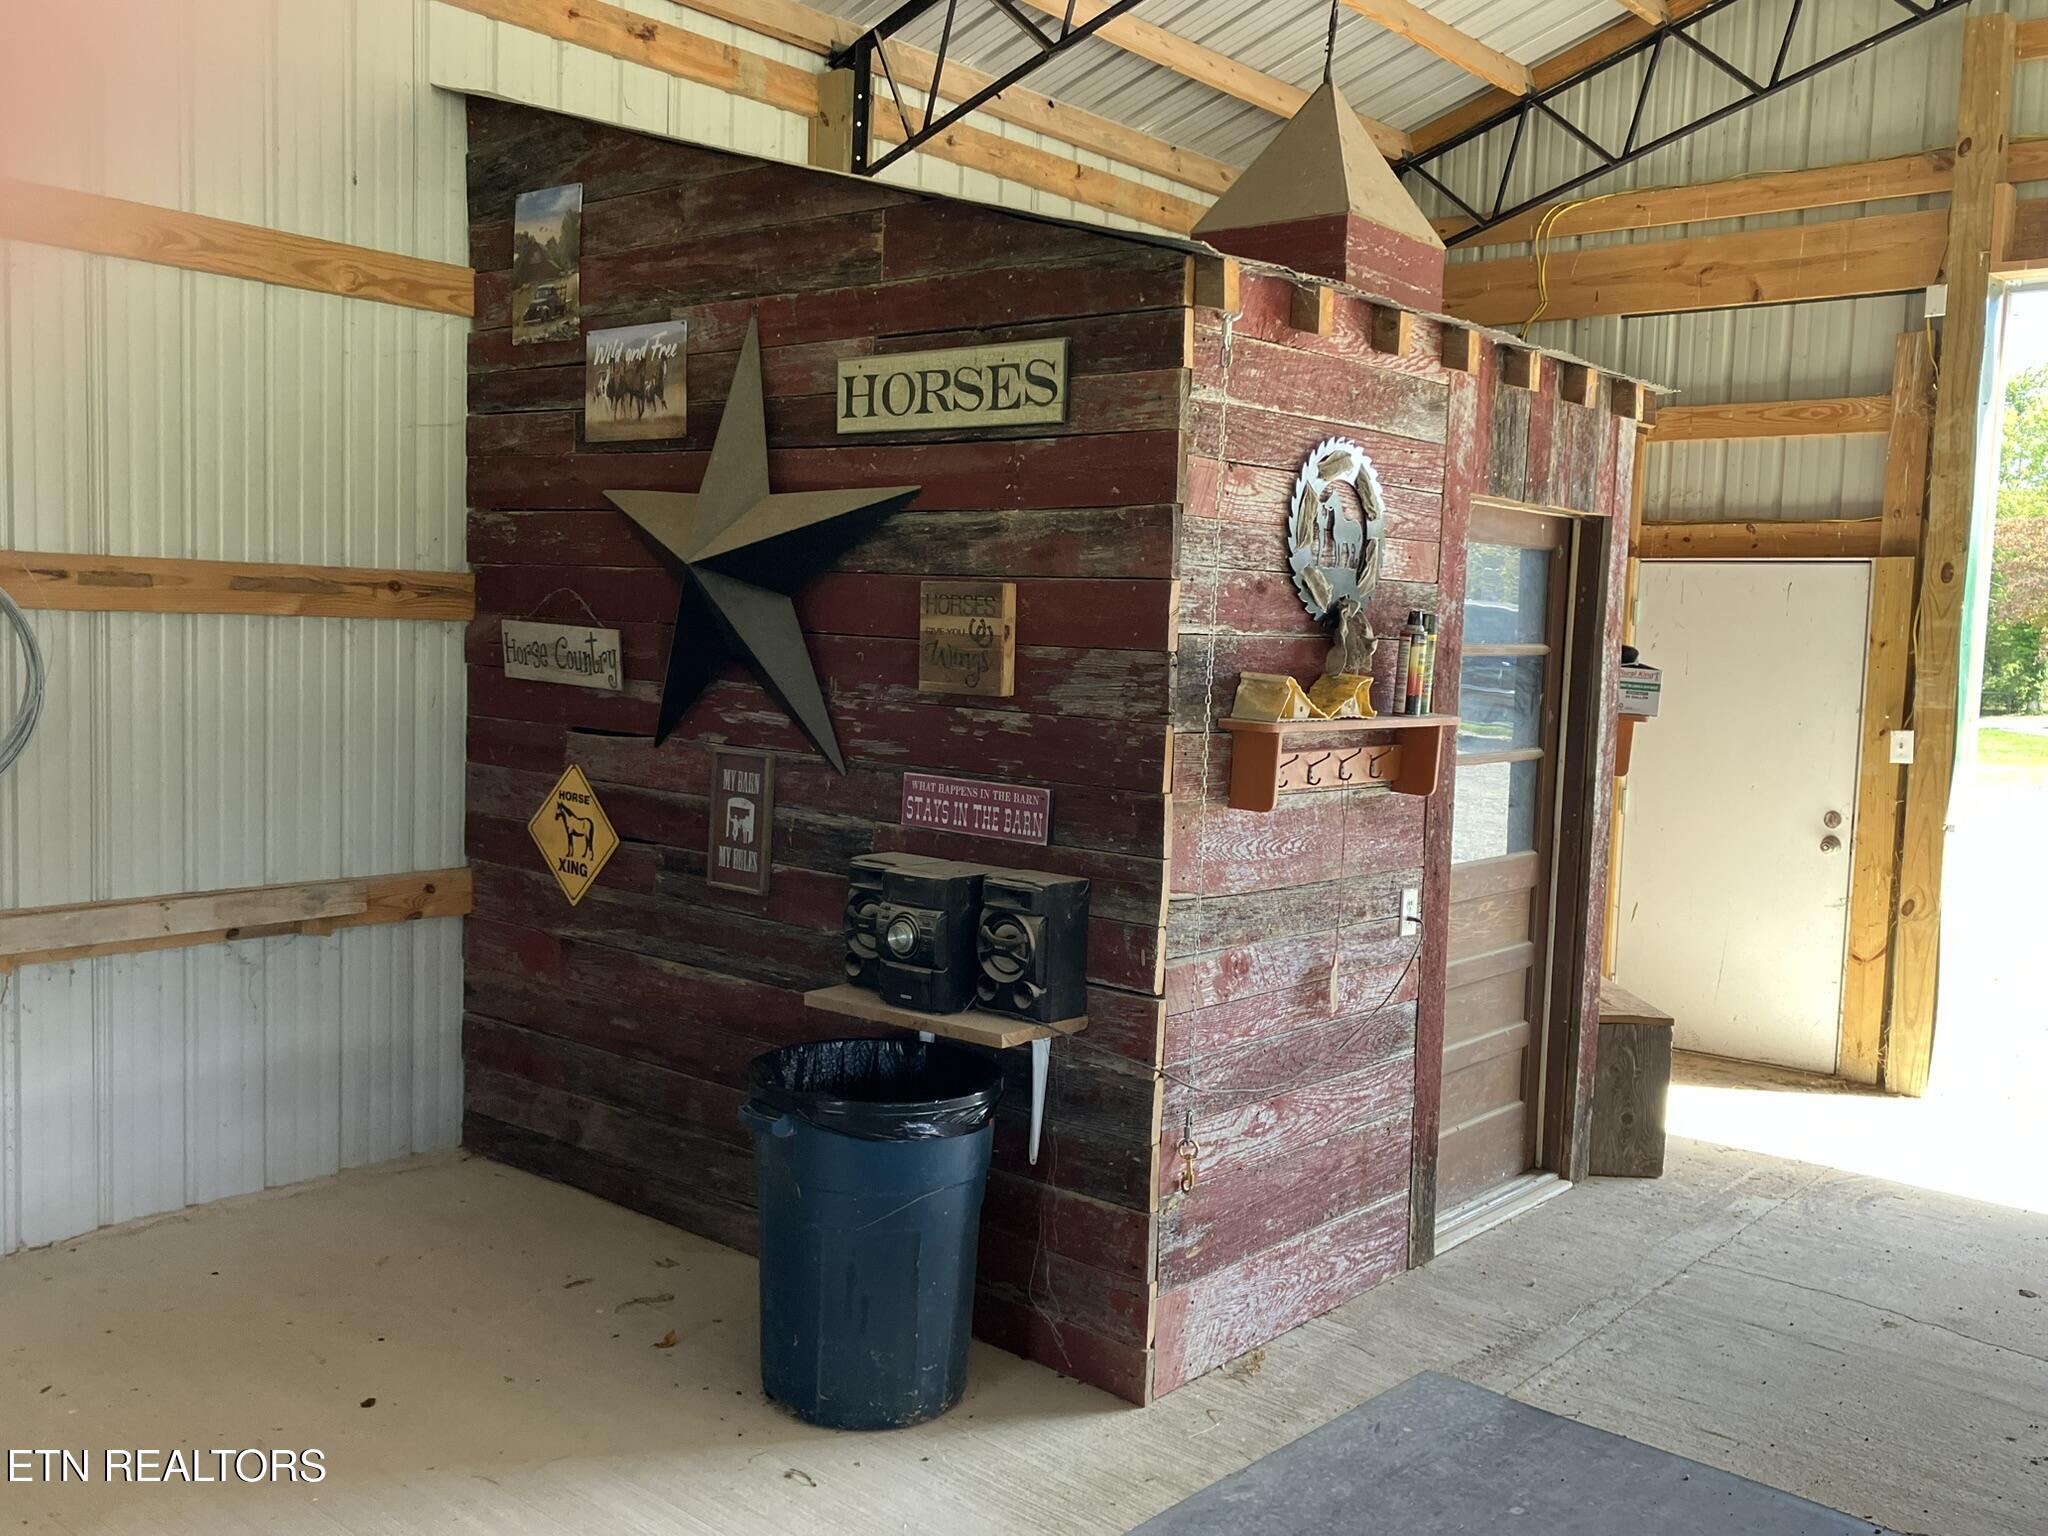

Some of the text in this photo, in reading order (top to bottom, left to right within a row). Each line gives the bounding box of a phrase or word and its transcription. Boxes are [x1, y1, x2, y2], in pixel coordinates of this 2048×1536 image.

[594, 331, 678, 366] Wild and Free
[841, 358, 1059, 419] HORSES
[925, 593, 997, 616] HORSES
[504, 631, 618, 689] Horse Country
[722, 768, 761, 795] MY BARN
[911, 780, 1040, 806] WHAT HAPPENS IN THE BARN
[558, 790, 591, 805] HORSE
[906, 795, 1044, 838] STAYS IN THE BARN
[558, 857, 588, 878] XING
[718, 845, 759, 873] MY RULES
